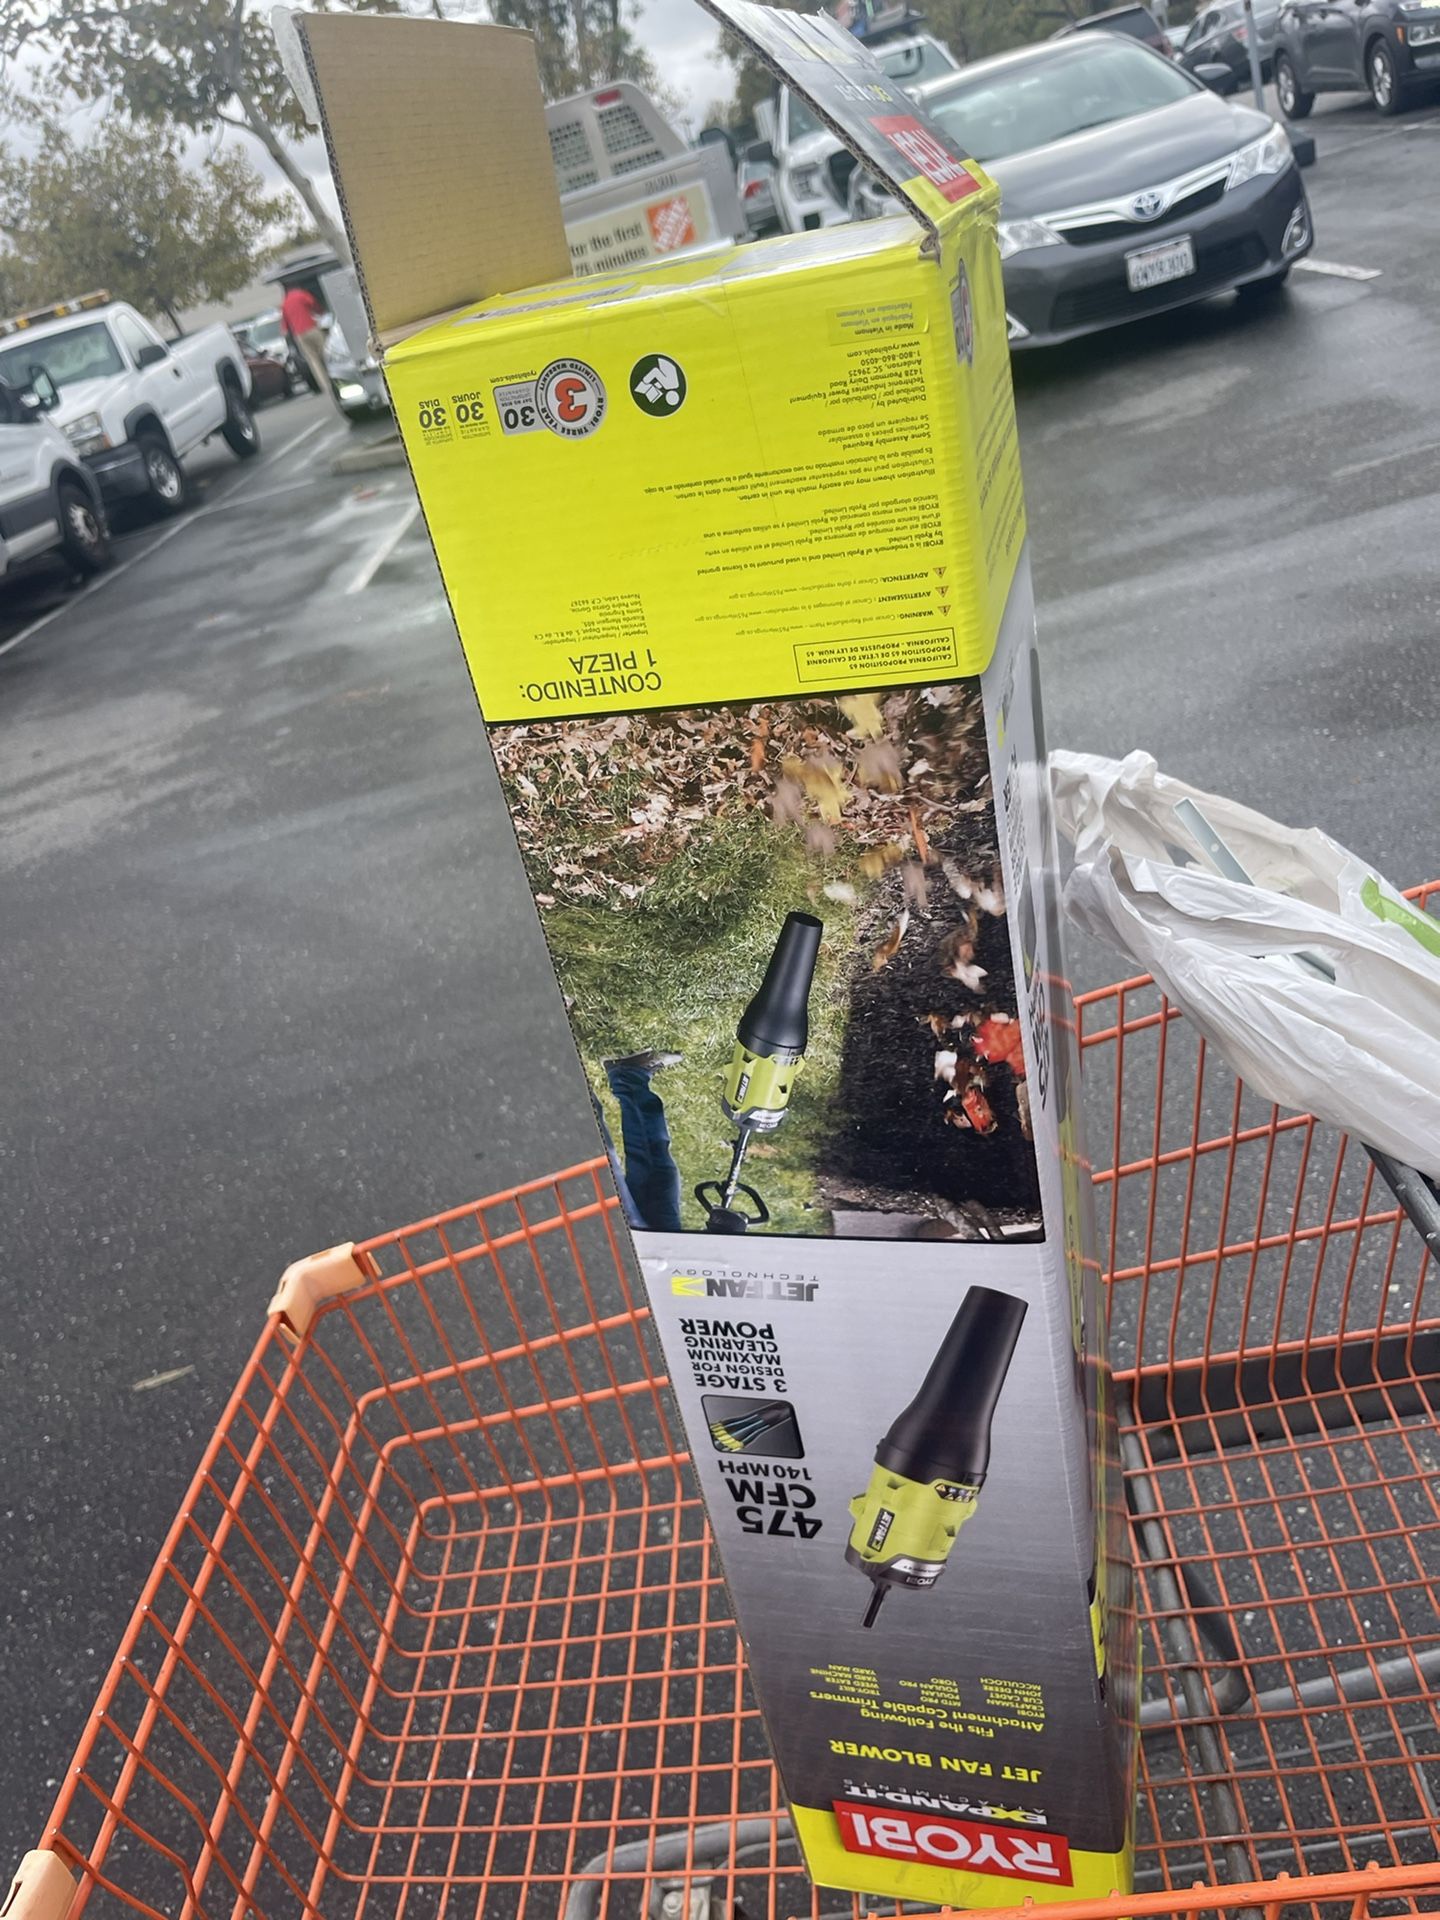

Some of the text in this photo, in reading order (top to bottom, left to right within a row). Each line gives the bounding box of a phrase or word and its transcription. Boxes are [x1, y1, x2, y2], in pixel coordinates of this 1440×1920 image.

[854, 326, 883, 336] Vietnam
[894, 322, 914, 331] Made
[847, 339, 920, 359] www.ryobitools.com
[860, 350, 920, 366] 1-800-860-4050
[848, 357, 922, 377] Anderson, SC 29625
[489, 370, 537, 384] ryobitools.com
[539, 363, 596, 391] LIMITED WARRANTY
[829, 368, 922, 389] 1428 Pearman Dairy Road
[789, 376, 924, 403] Techtronic Industries Power Equipment
[882, 388, 894, 396] par
[451, 392, 481, 404] JOURS
[554, 378, 588, 423] 3
[829, 396, 840, 404] por
[876, 394, 926, 407] Distributed by
[418, 399, 440, 410] DÍAS
[419, 407, 446, 429] 30
[456, 401, 484, 424] 30
[504, 406, 535, 430] 30
[540, 398, 604, 436] RYOBI THREE YEAR
[920, 414, 929, 422] Se
[857, 421, 874, 430] poco
[887, 414, 918, 426] requiere
[818, 427, 845, 437] armado
[846, 425, 856, 433] de
[895, 423, 930, 434] Certaines
[828, 432, 863, 443] assembler
[842, 432, 931, 450] Some Assembly Required
[856, 476, 871, 484] may
[872, 474, 896, 483] shown
[897, 468, 935, 480] Illustration
[796, 485, 817, 494] match
[818, 480, 841, 491] exactly
[737, 493, 760, 502] carton.
[769, 490, 782, 498] unit
[784, 488, 795, 496] the
[887, 530, 943, 544] by Ryobi Limited.
[874, 543, 908, 554] trademark
[922, 539, 944, 548] RYOBI
[808, 554, 821, 562] and
[822, 551, 845, 560] Limited
[846, 547, 864, 557] Ryobi
[785, 557, 800, 565] used
[697, 565, 720, 576] granted
[722, 564, 742, 573] license
[879, 571, 928, 584] ADVERTENCIA:
[878, 590, 931, 602] AVERTISSEMENT
[896, 610, 933, 620] WARNING:
[860, 641, 899, 651] PROPUESTA
[906, 636, 950, 647] CALIFORNIA
[901, 645, 950, 656] PROPOSITION
[568, 648, 656, 675] 1 PIEZA
[807, 656, 846, 666] CALIFORNIE
[859, 658, 907, 669] PROPOSITION
[908, 653, 951, 664] CALIFORNIA
[519, 672, 662, 702] CONTENIDO:
[671, 1268, 819, 1282] TECHNOLOGY
[706, 1278, 818, 1302] JET FAN
[678, 1318, 775, 1340] POWER
[684, 1336, 778, 1353] CLEARING
[686, 1348, 781, 1365] MAXIMUM
[691, 1361, 784, 1377] DESIGN FOR
[693, 1373, 788, 1393] 3 STAGE
[717, 1460, 812, 1482] 140 MPH
[724, 1478, 816, 1510] CFM
[736, 1505, 824, 1540] 475
[828, 1664, 876, 1675] YARD MAN
[824, 1677, 851, 1686] EATER
[853, 1673, 877, 1682] YARD
[980, 1677, 1042, 1690] MCCULLOCH
[898, 1680, 958, 1693] POULAN PRO
[1014, 1688, 1042, 1697] JOHN
[921, 1689, 960, 1700] POULAN
[989, 1692, 1044, 1704] CUB CADET
[920, 1696, 961, 1706] MTD PRO
[986, 1698, 1044, 1711] CRAFTSMAN
[810, 1690, 1044, 1732] Attachment Capable Trimmers
[1017, 1709, 1045, 1718] RYOBI
[860, 1708, 994, 1738] Fits the Following
[829, 1740, 1042, 1784] JET FAN BLOWER
[843, 1778, 1045, 1814] ATTACHMENTS
[845, 1786, 1047, 1826] EXPAND-IT
[850, 1812, 1060, 1876] RYOBI
